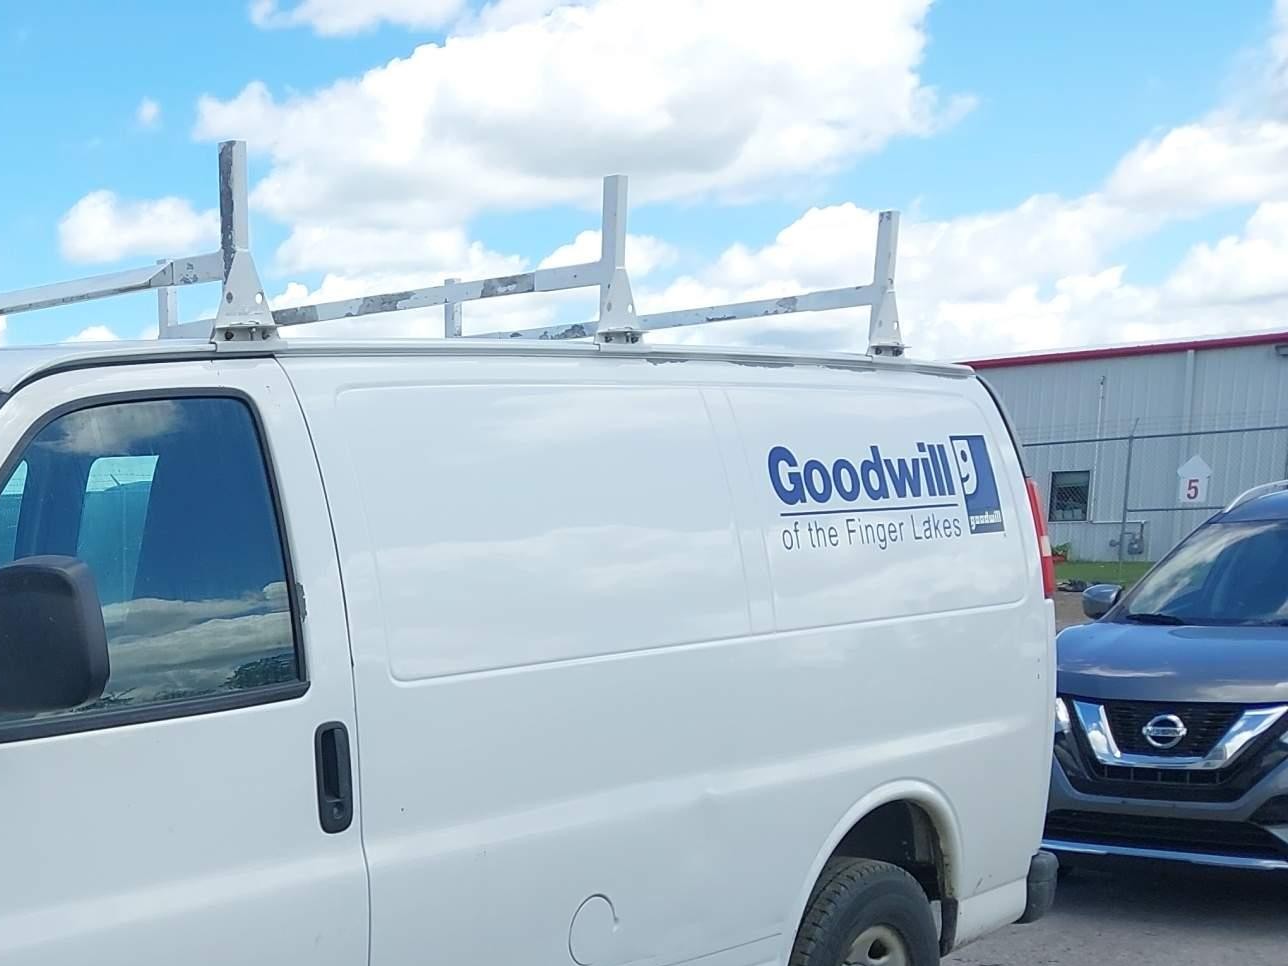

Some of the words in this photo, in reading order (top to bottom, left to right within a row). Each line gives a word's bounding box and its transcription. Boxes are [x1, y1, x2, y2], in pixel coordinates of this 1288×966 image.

[767, 442, 956, 505] Goodwill
[1186, 479, 1200, 500] 5
[782, 521, 800, 549] of
[808, 520, 839, 549] the
[845, 518, 905, 551] Finger
[910, 513, 962, 540] Lakes
